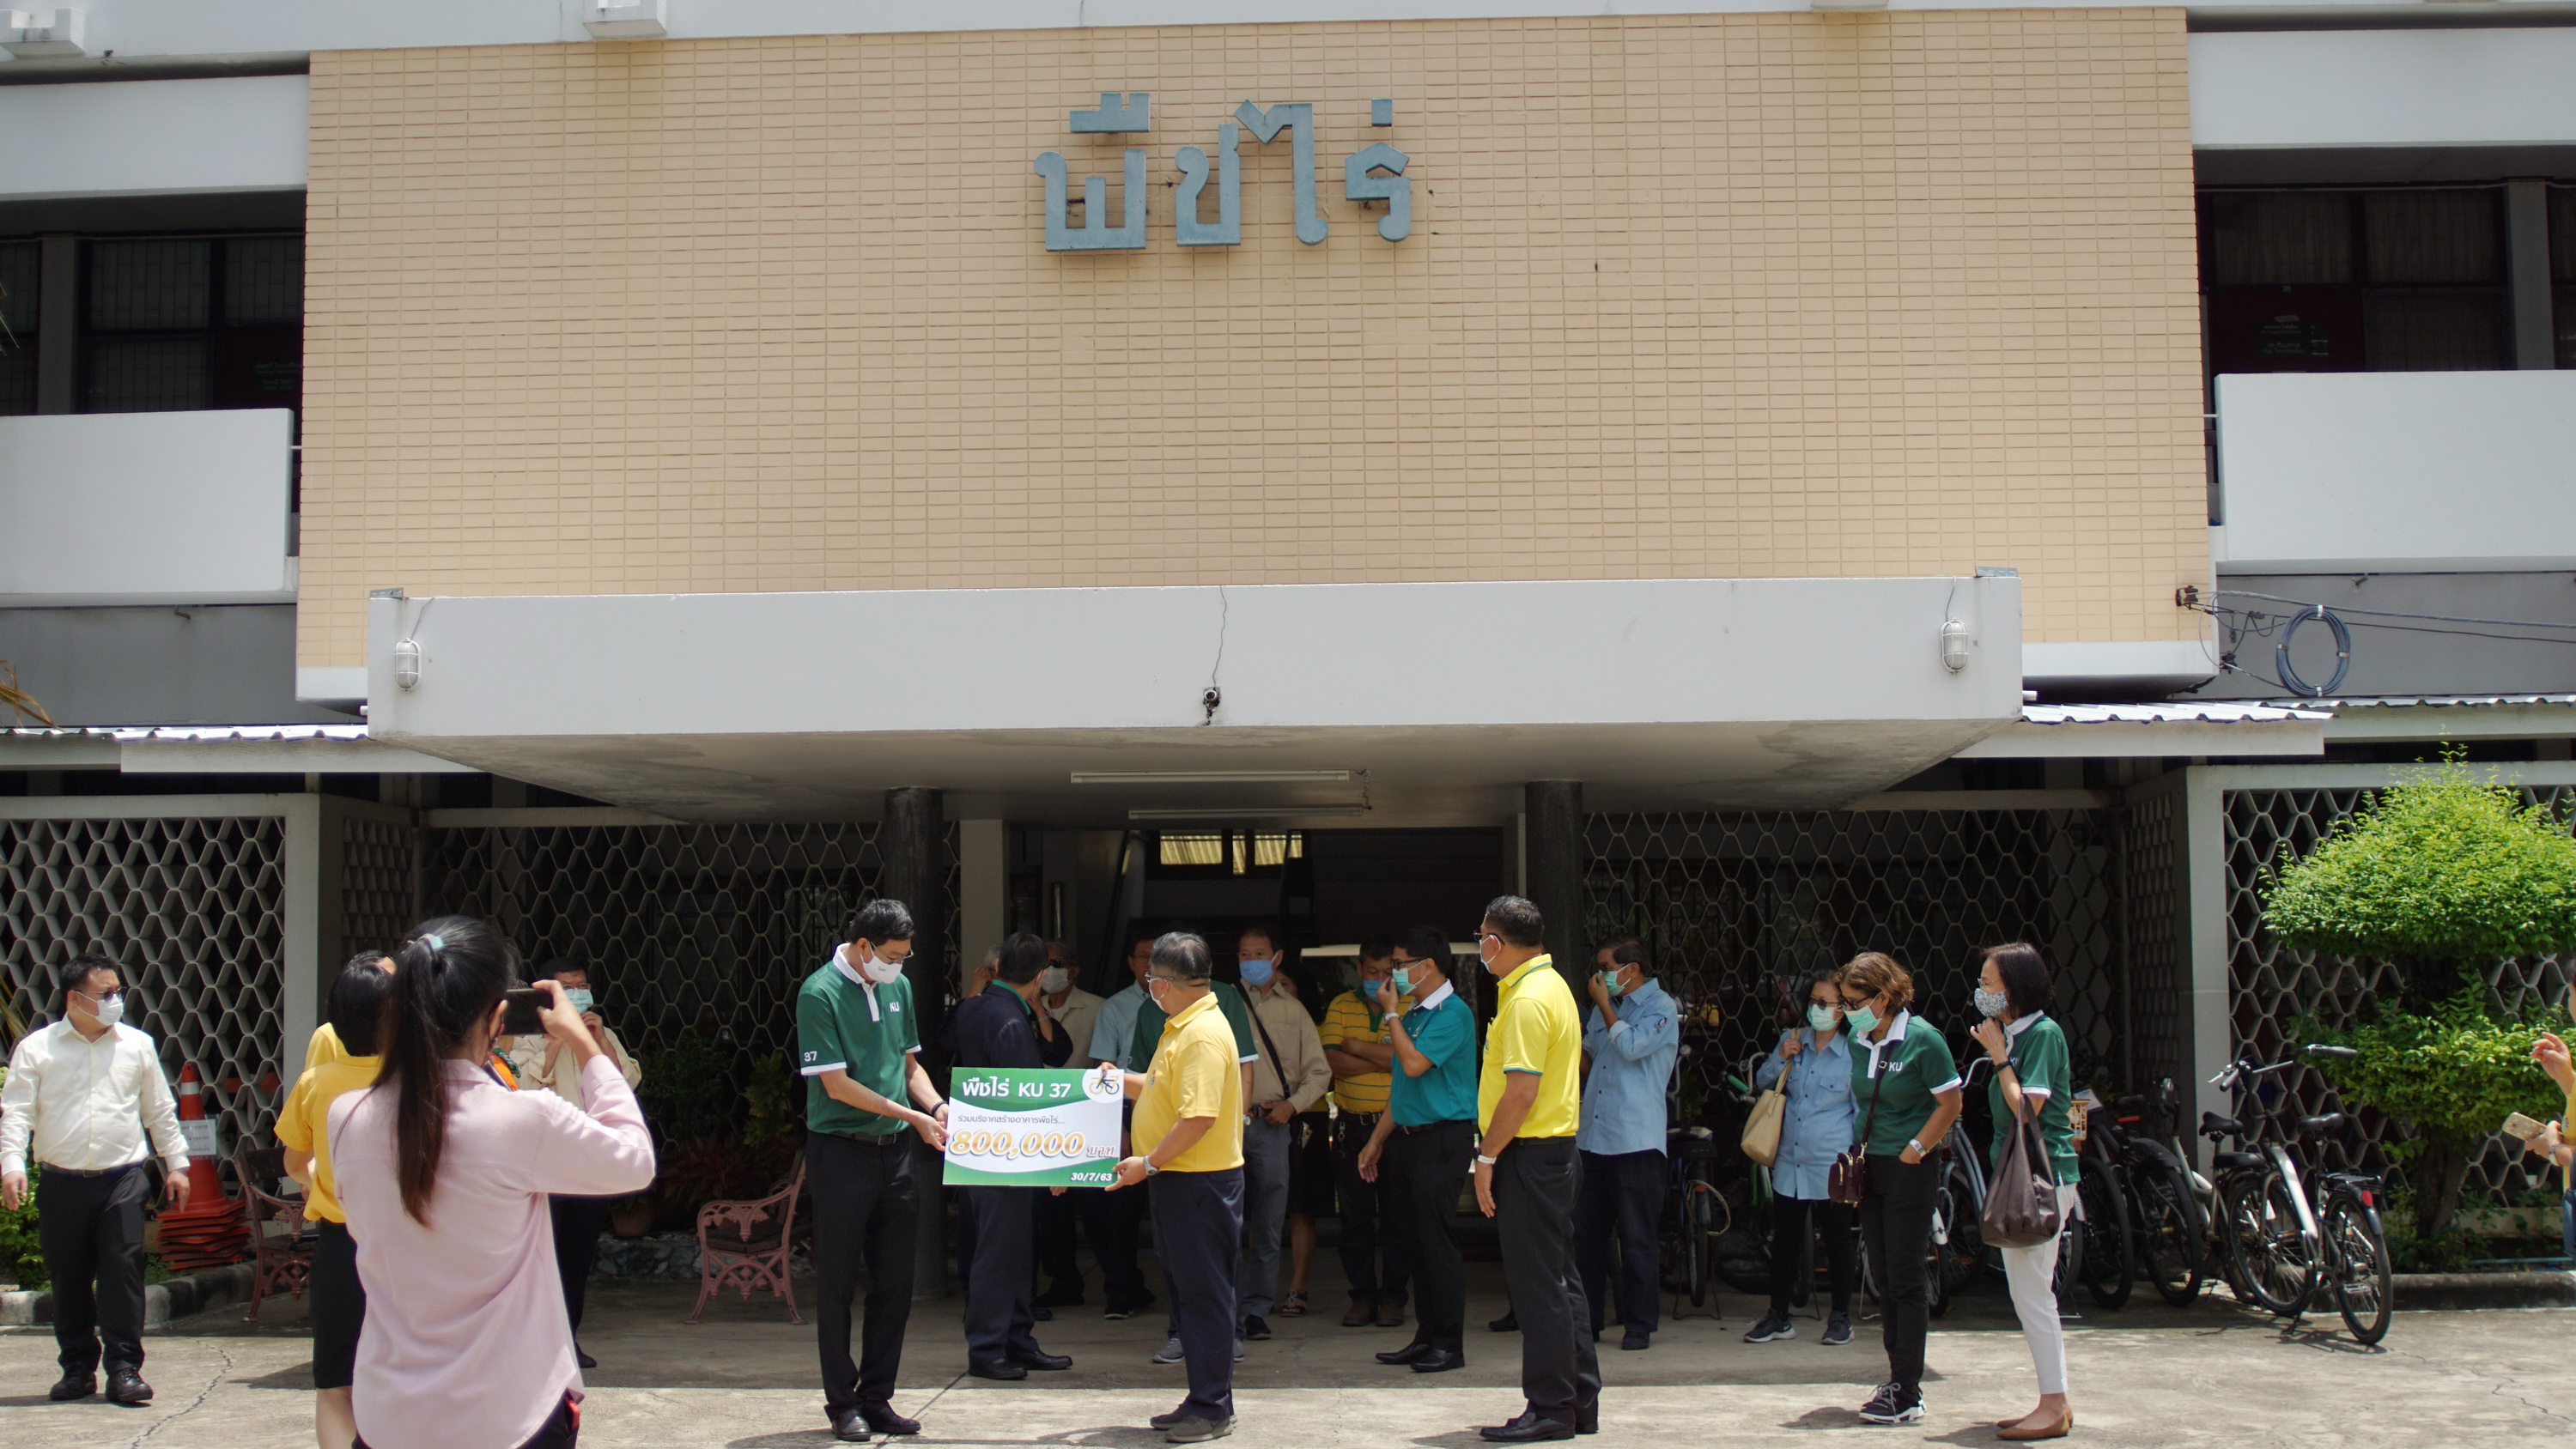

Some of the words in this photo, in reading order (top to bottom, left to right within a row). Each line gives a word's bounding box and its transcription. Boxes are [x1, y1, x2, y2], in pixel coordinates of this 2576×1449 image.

[1034, 92, 1412, 252] พืชไร่
[889, 1002, 900, 1012] KU
[804, 1051, 817, 1062] 37
[1888, 1061, 1903, 1071] KU
[962, 1076, 1010, 1097] พืชไร่
[1018, 1082, 1044, 1098] KU
[1049, 1083, 1072, 1098] 37
[950, 1129, 1085, 1160] 800,000
[1087, 1144, 1115, 1158] บาท
[1071, 1172, 1113, 1182] 30/7/63
